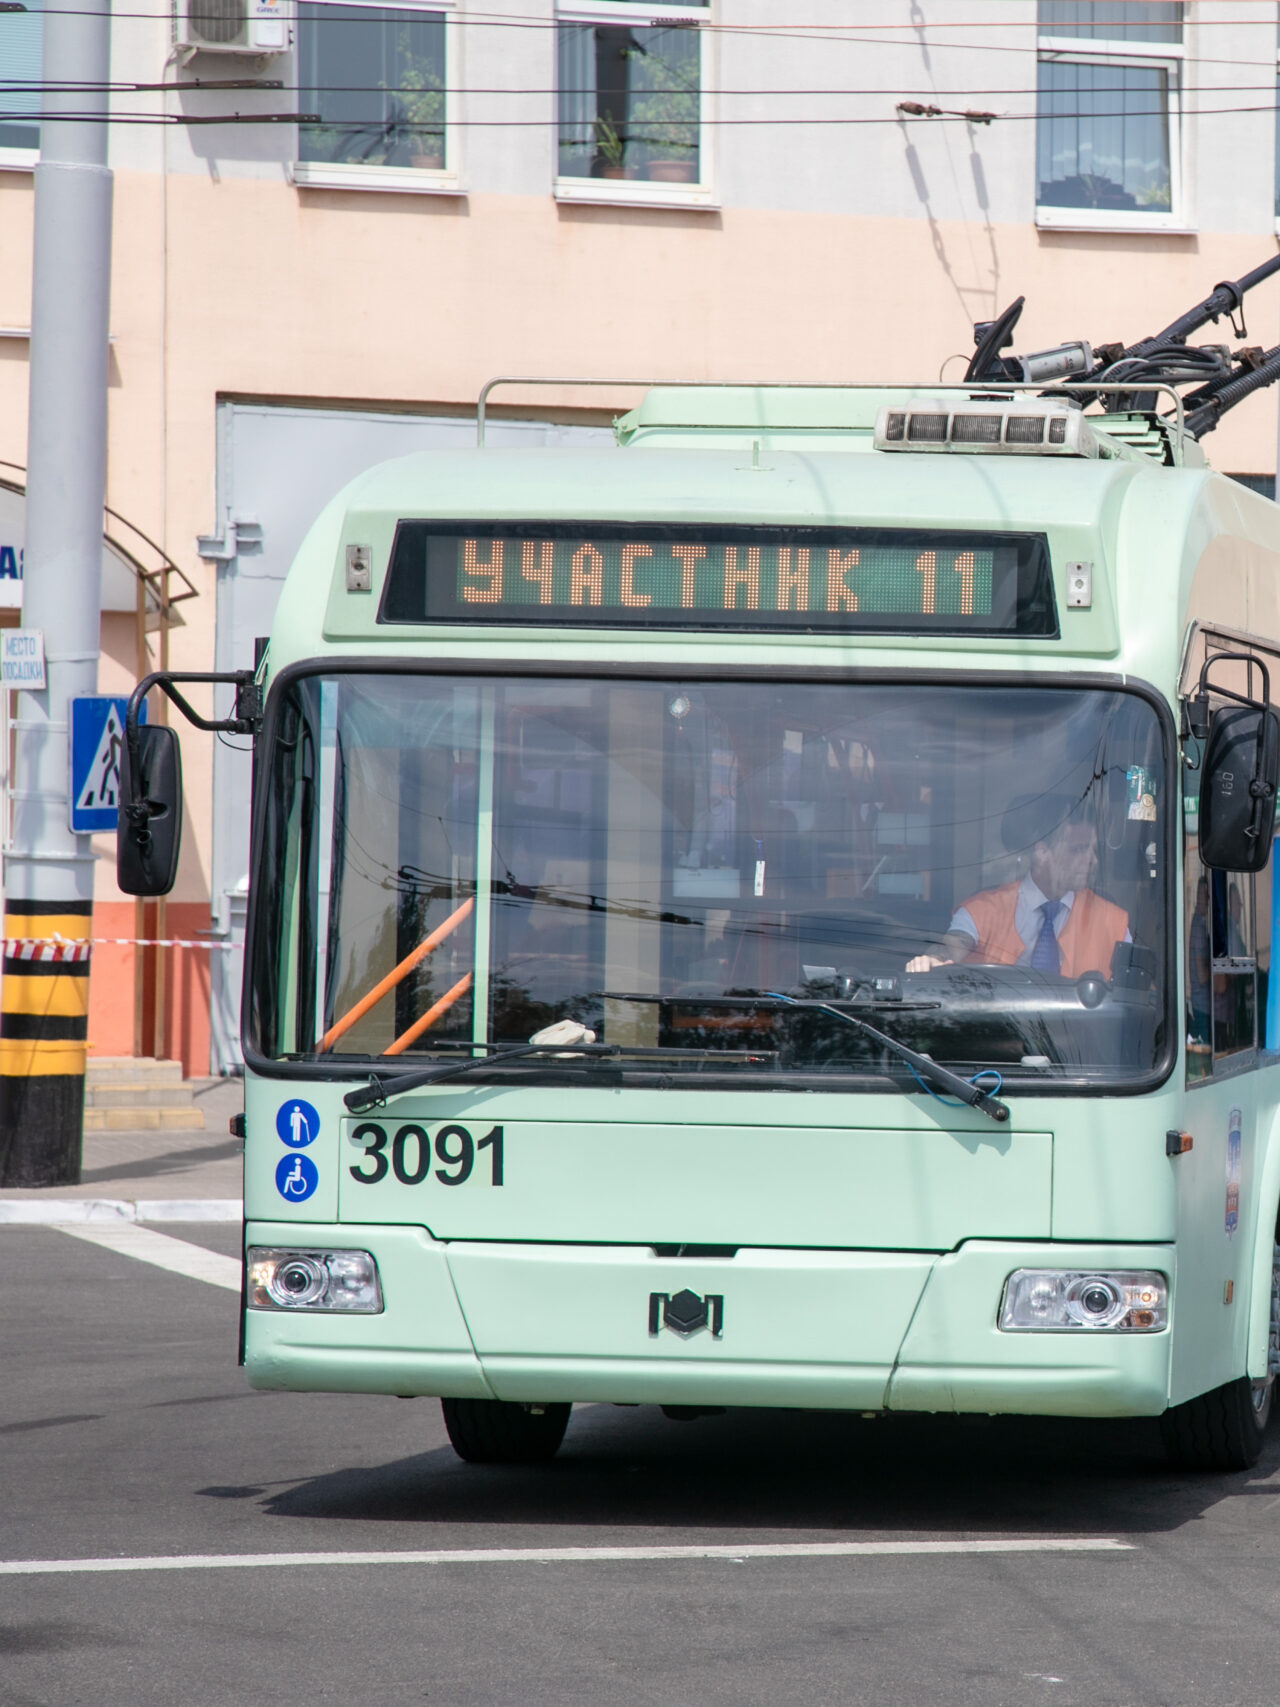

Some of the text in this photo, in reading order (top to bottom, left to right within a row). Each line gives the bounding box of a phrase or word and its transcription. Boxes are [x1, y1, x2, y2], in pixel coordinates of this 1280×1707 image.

[453, 539, 975, 615] УЧАСТНИК 11
[6, 637, 36, 656] МЕСТО
[3, 661, 43, 681] ПОСАДКИ
[349, 1122, 504, 1187] 3091
